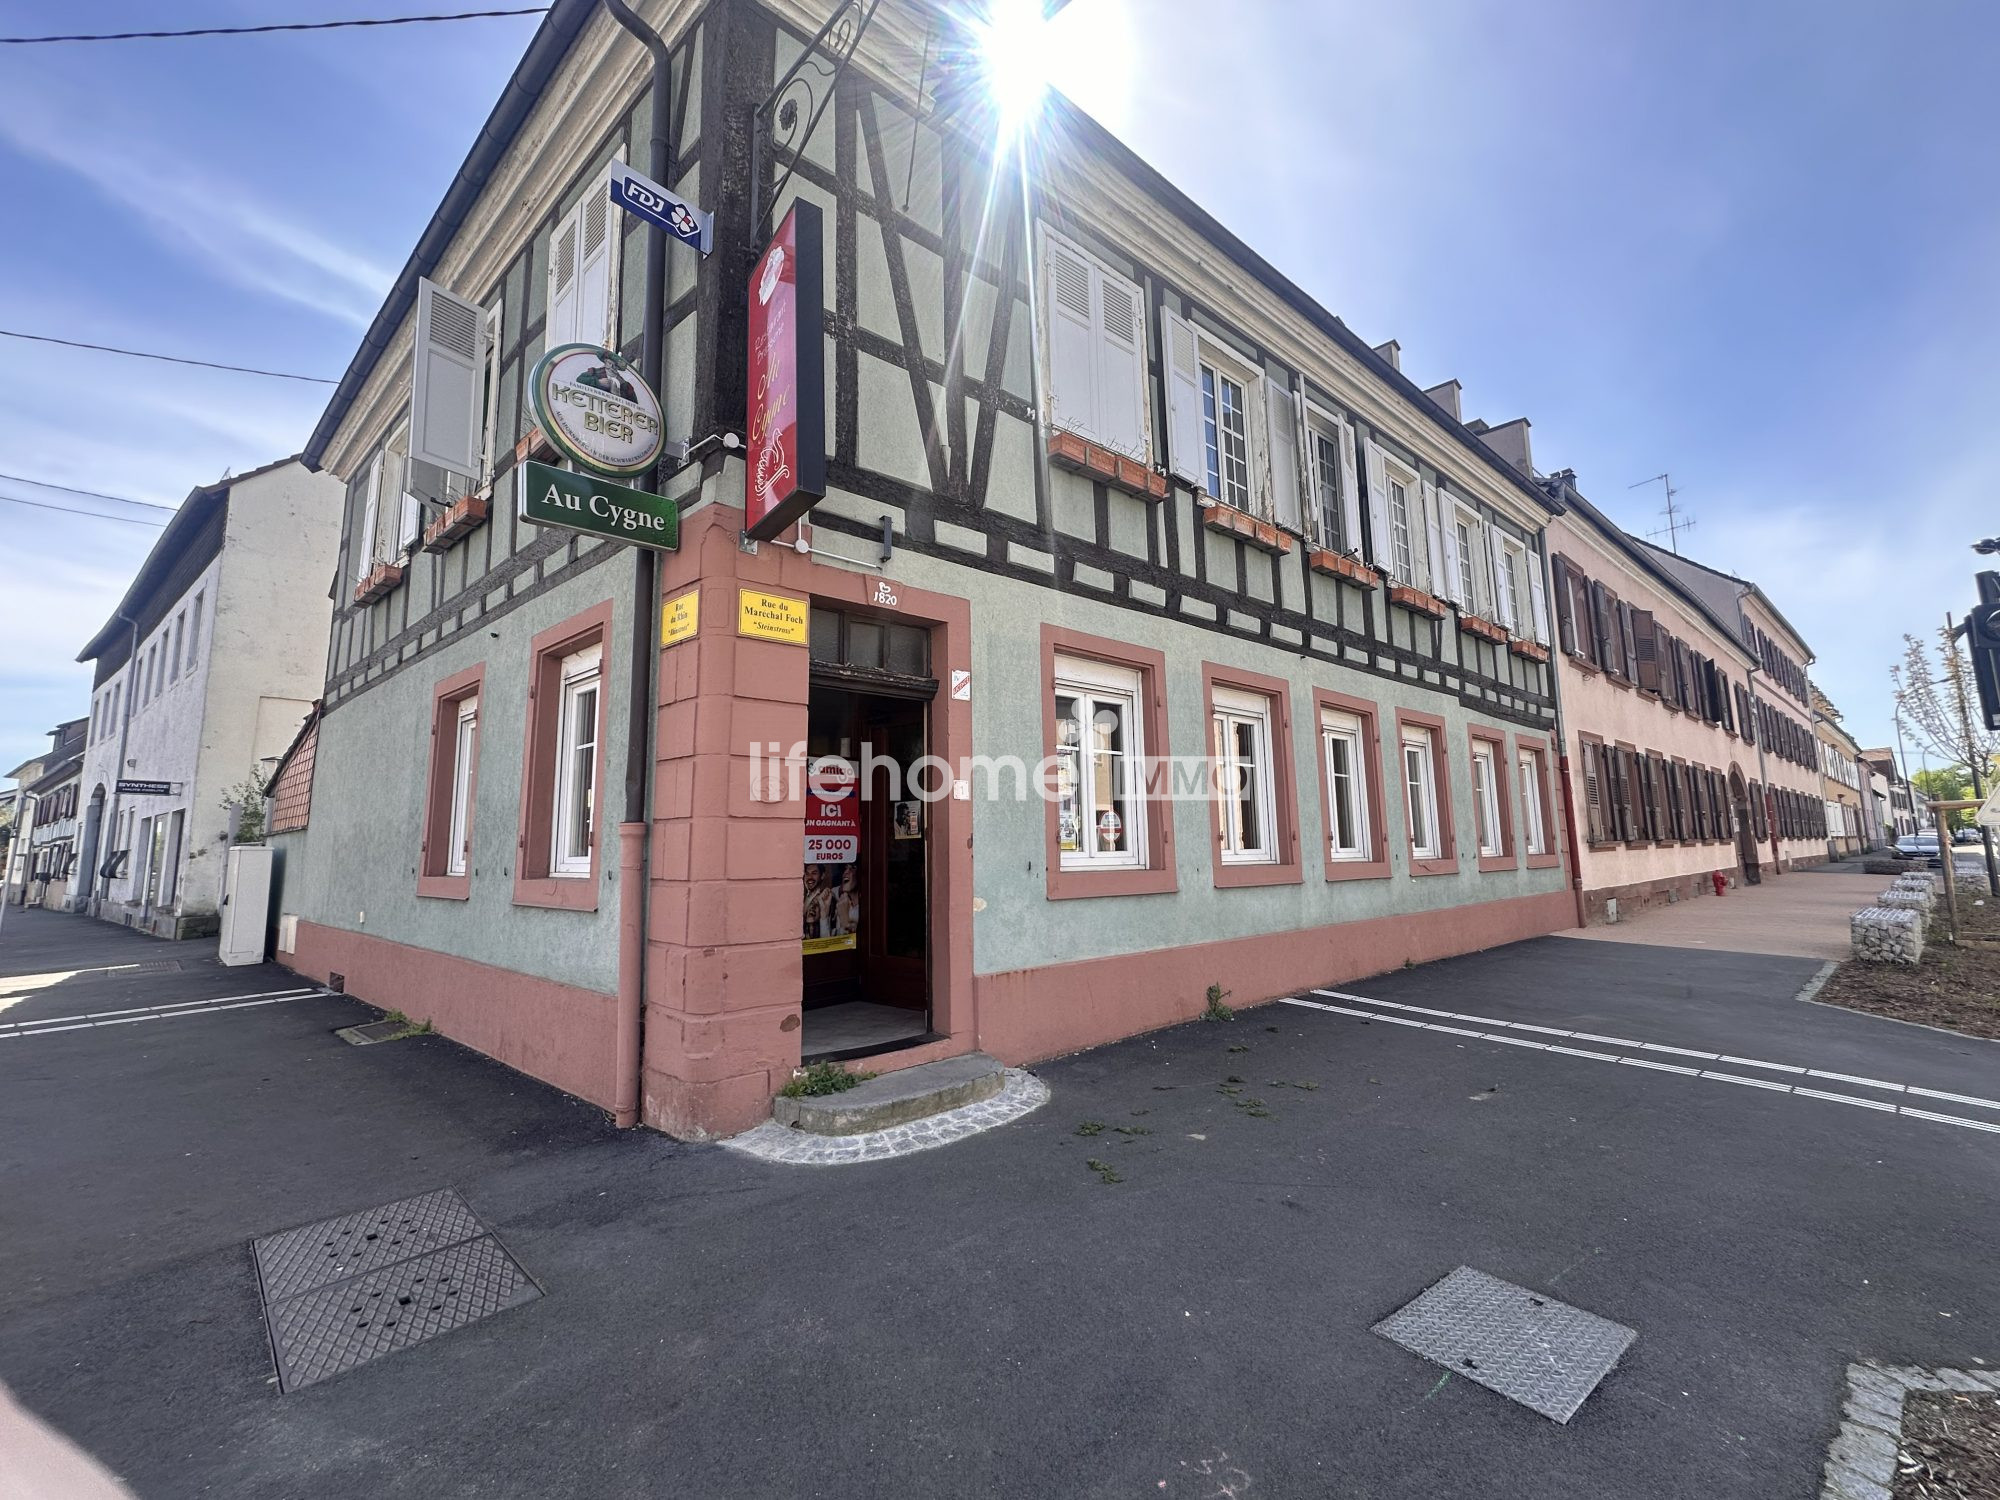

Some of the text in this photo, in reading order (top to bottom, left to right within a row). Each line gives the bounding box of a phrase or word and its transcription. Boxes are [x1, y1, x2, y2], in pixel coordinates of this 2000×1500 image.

[628, 183, 664, 212] FDJ
[551, 382, 659, 436] KETTERER
[584, 411, 634, 444] BIER
[541, 484, 665, 530] Au Cygne
[761, 598, 789, 612] Rue du
[873, 591, 898, 606] 1820
[785, 613, 804, 625] Foch
[820, 804, 842, 817] ICI
[816, 819, 850, 827] GAGNANT
[808, 839, 851, 850] 25 000
[816, 852, 844, 861] EUROS
